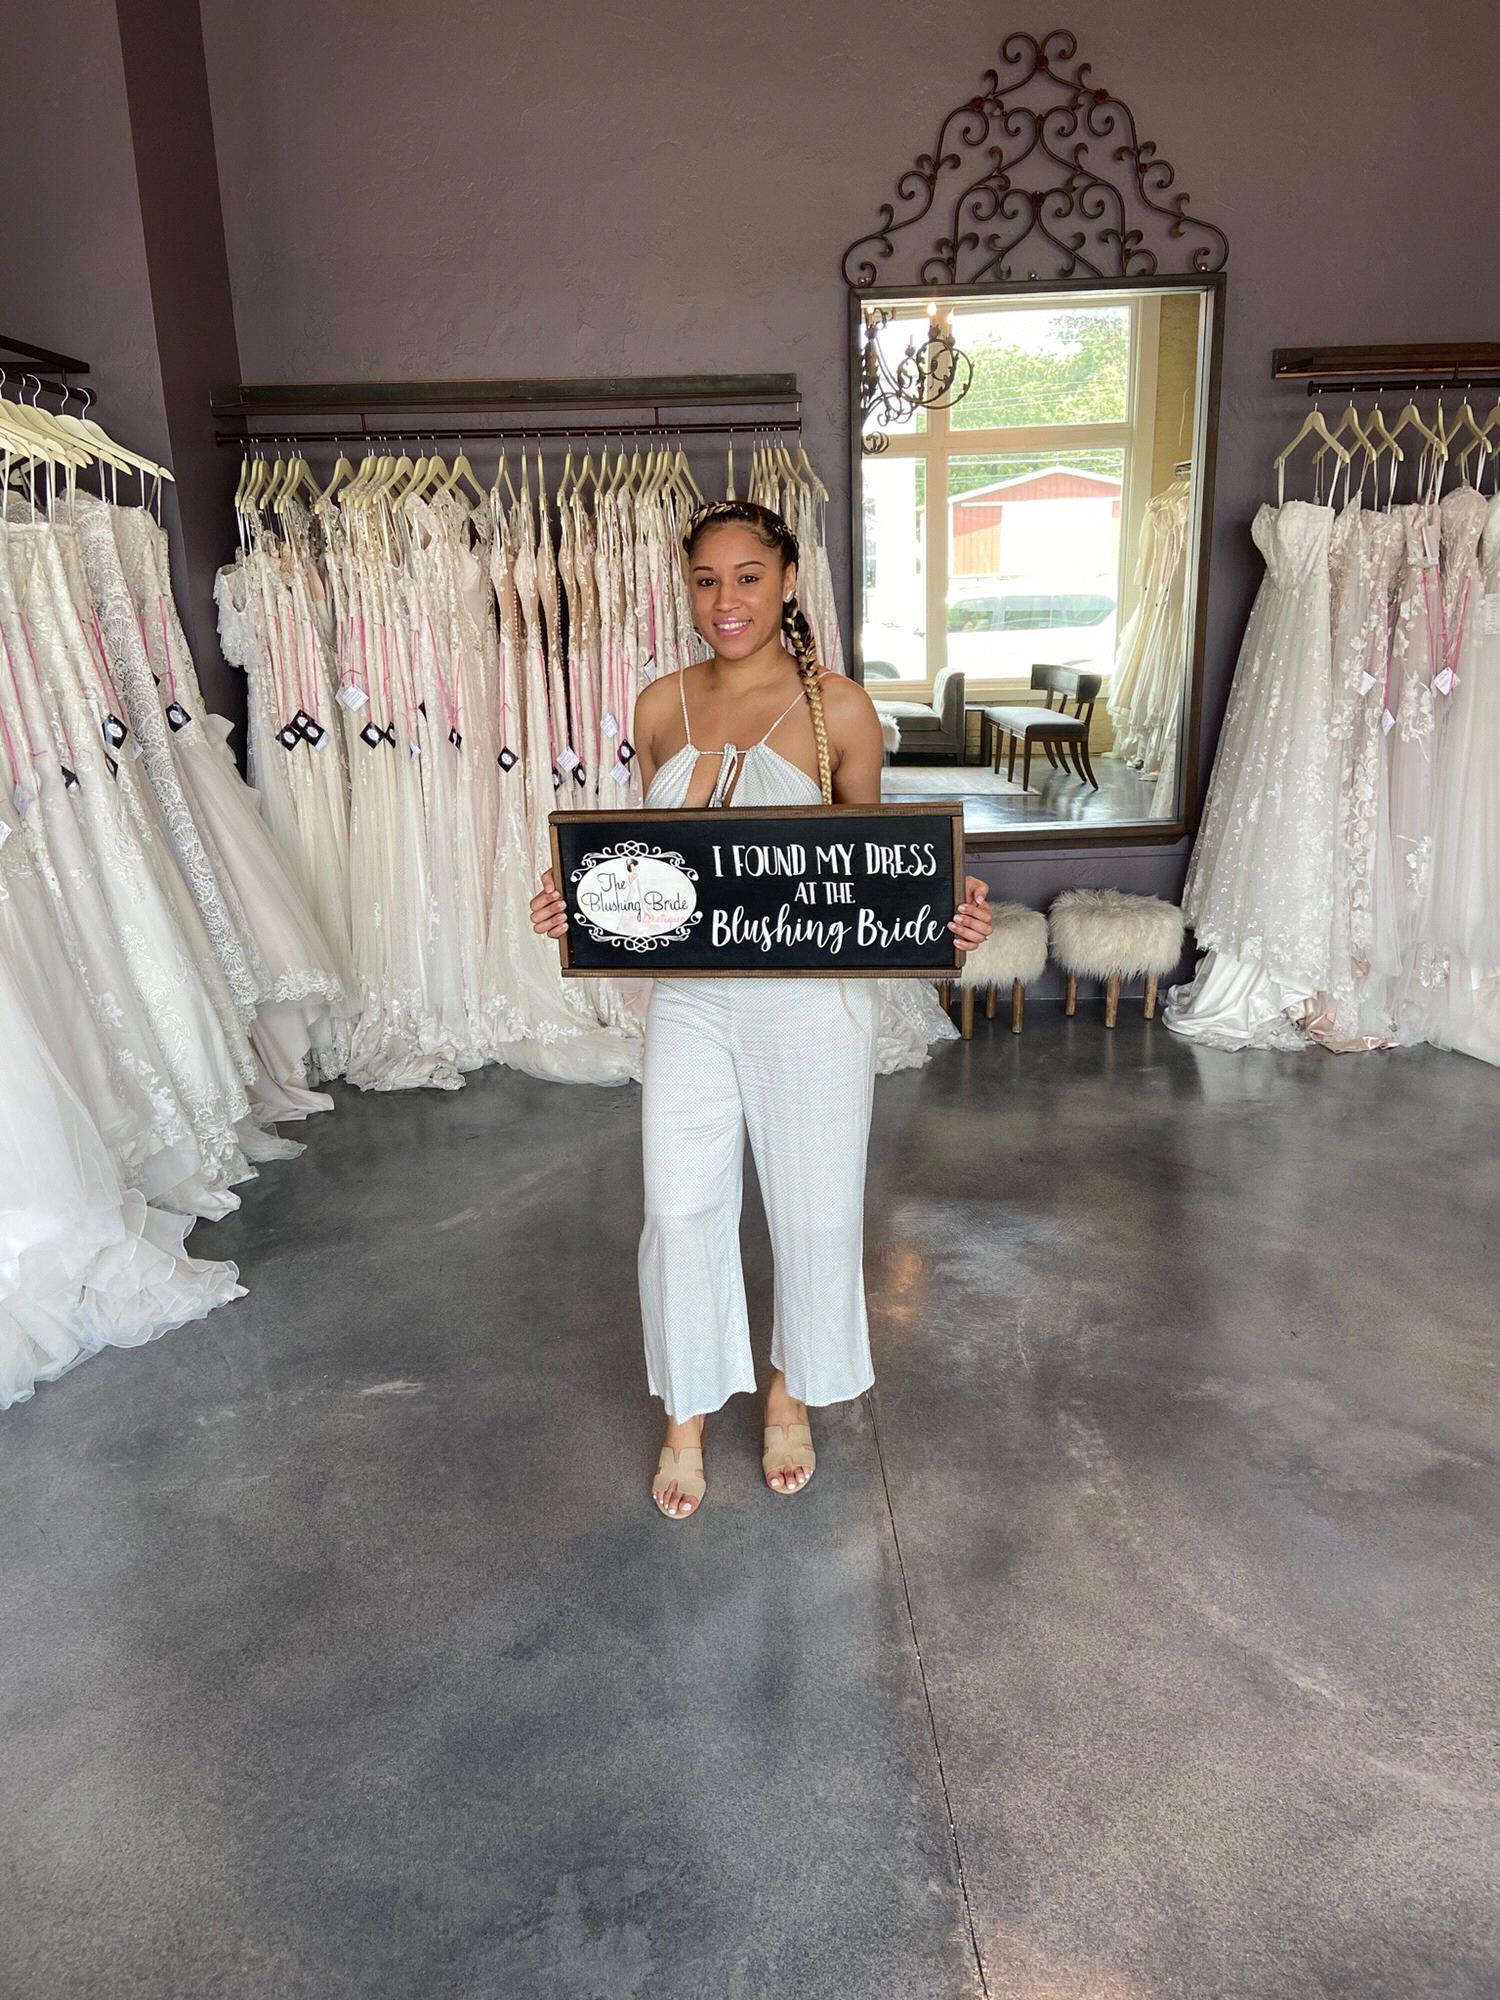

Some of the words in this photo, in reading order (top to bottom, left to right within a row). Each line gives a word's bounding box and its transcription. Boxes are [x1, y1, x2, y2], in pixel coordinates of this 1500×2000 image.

[712, 845, 724, 877] I
[732, 844, 806, 877] FOUND
[815, 844, 855, 876] MY
[865, 843, 937, 878] DRESS
[597, 873, 625, 892] The
[795, 882, 817, 904] AT
[822, 882, 856, 905] THE
[581, 892, 641, 922] Blushing
[644, 891, 689, 911] Bride
[712, 903, 852, 954] Blushing
[858, 904, 945, 948] Bride
